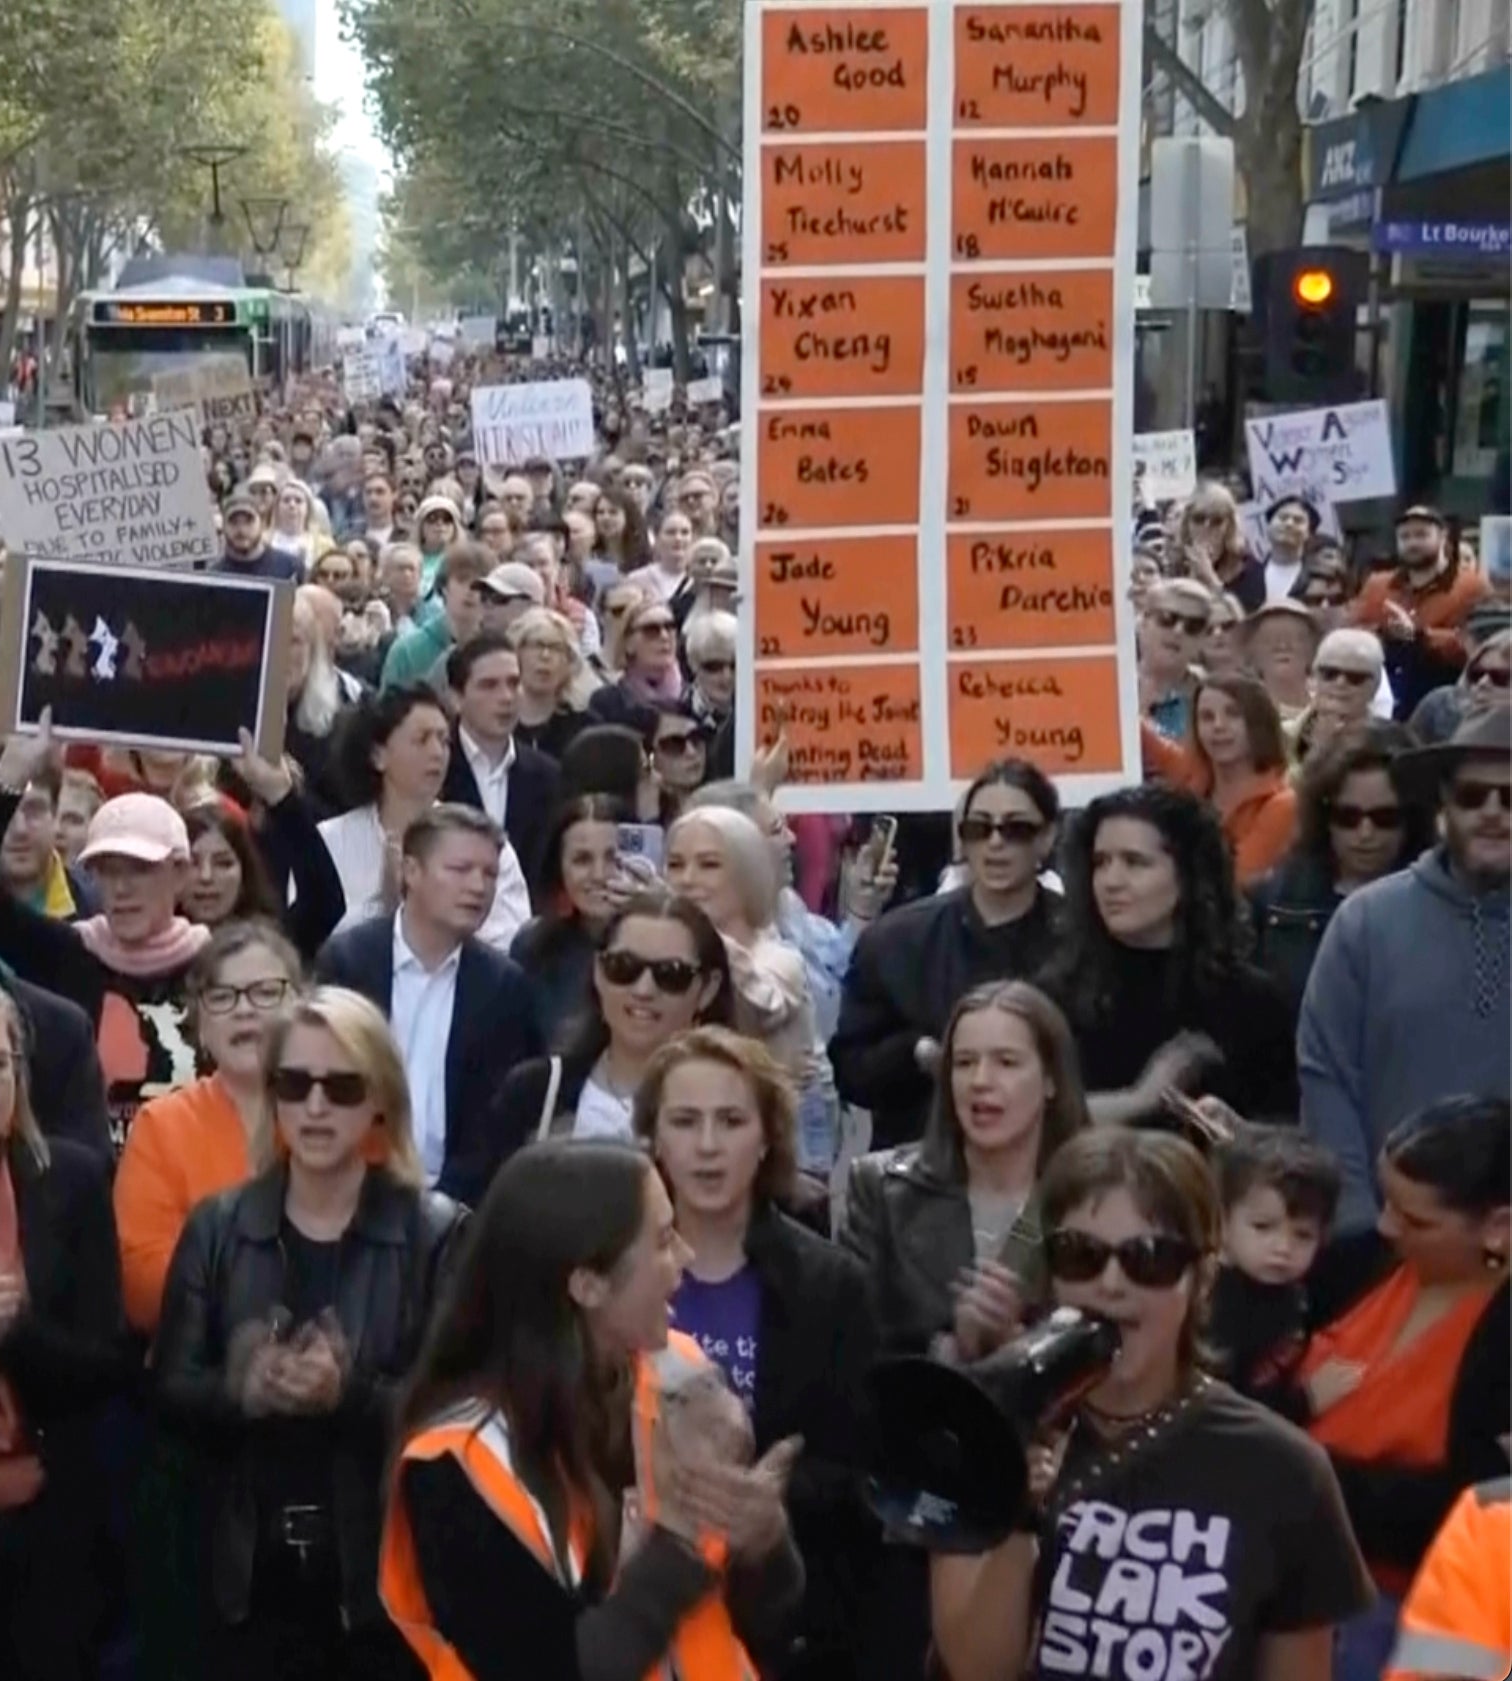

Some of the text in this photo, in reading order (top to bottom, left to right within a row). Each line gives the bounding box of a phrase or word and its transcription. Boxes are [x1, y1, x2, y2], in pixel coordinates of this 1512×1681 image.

[786, 23, 890, 54] Ashlee
[966, 16, 1102, 43] Samantha
[833, 61, 905, 88] Good
[992, 64, 1087, 118] Murphy
[767, 105, 800, 129] 20
[959, 101, 981, 120] 12
[773, 153, 863, 194] Molly
[971, 153, 1073, 189] Hannah
[957, 232, 981, 259] 18
[770, 286, 856, 318] Yixan
[967, 283, 1064, 311] Swetha
[793, 331, 891, 373] Cheng
[957, 365, 978, 385] 15
[768, 416, 831, 441] Emma
[967, 414, 1038, 438] Dawn
[1, 415, 197, 480] 13 WOMEN
[23, 460, 181, 505] HOSPITALISED
[796, 455, 869, 484] Bates
[986, 446, 1109, 493] Singleton
[54, 491, 162, 532] EVERYDAY
[76, 529, 105, 549] TO
[131, 537, 213, 563] VIOLENCE
[769, 552, 836, 583] Jade
[970, 541, 1057, 573] Pikria
[801, 598, 890, 646] Young
[953, 626, 977, 646] 23
[761, 637, 782, 655] 22
[858, 738, 909, 762] Dead
[994, 716, 1085, 761] Young
